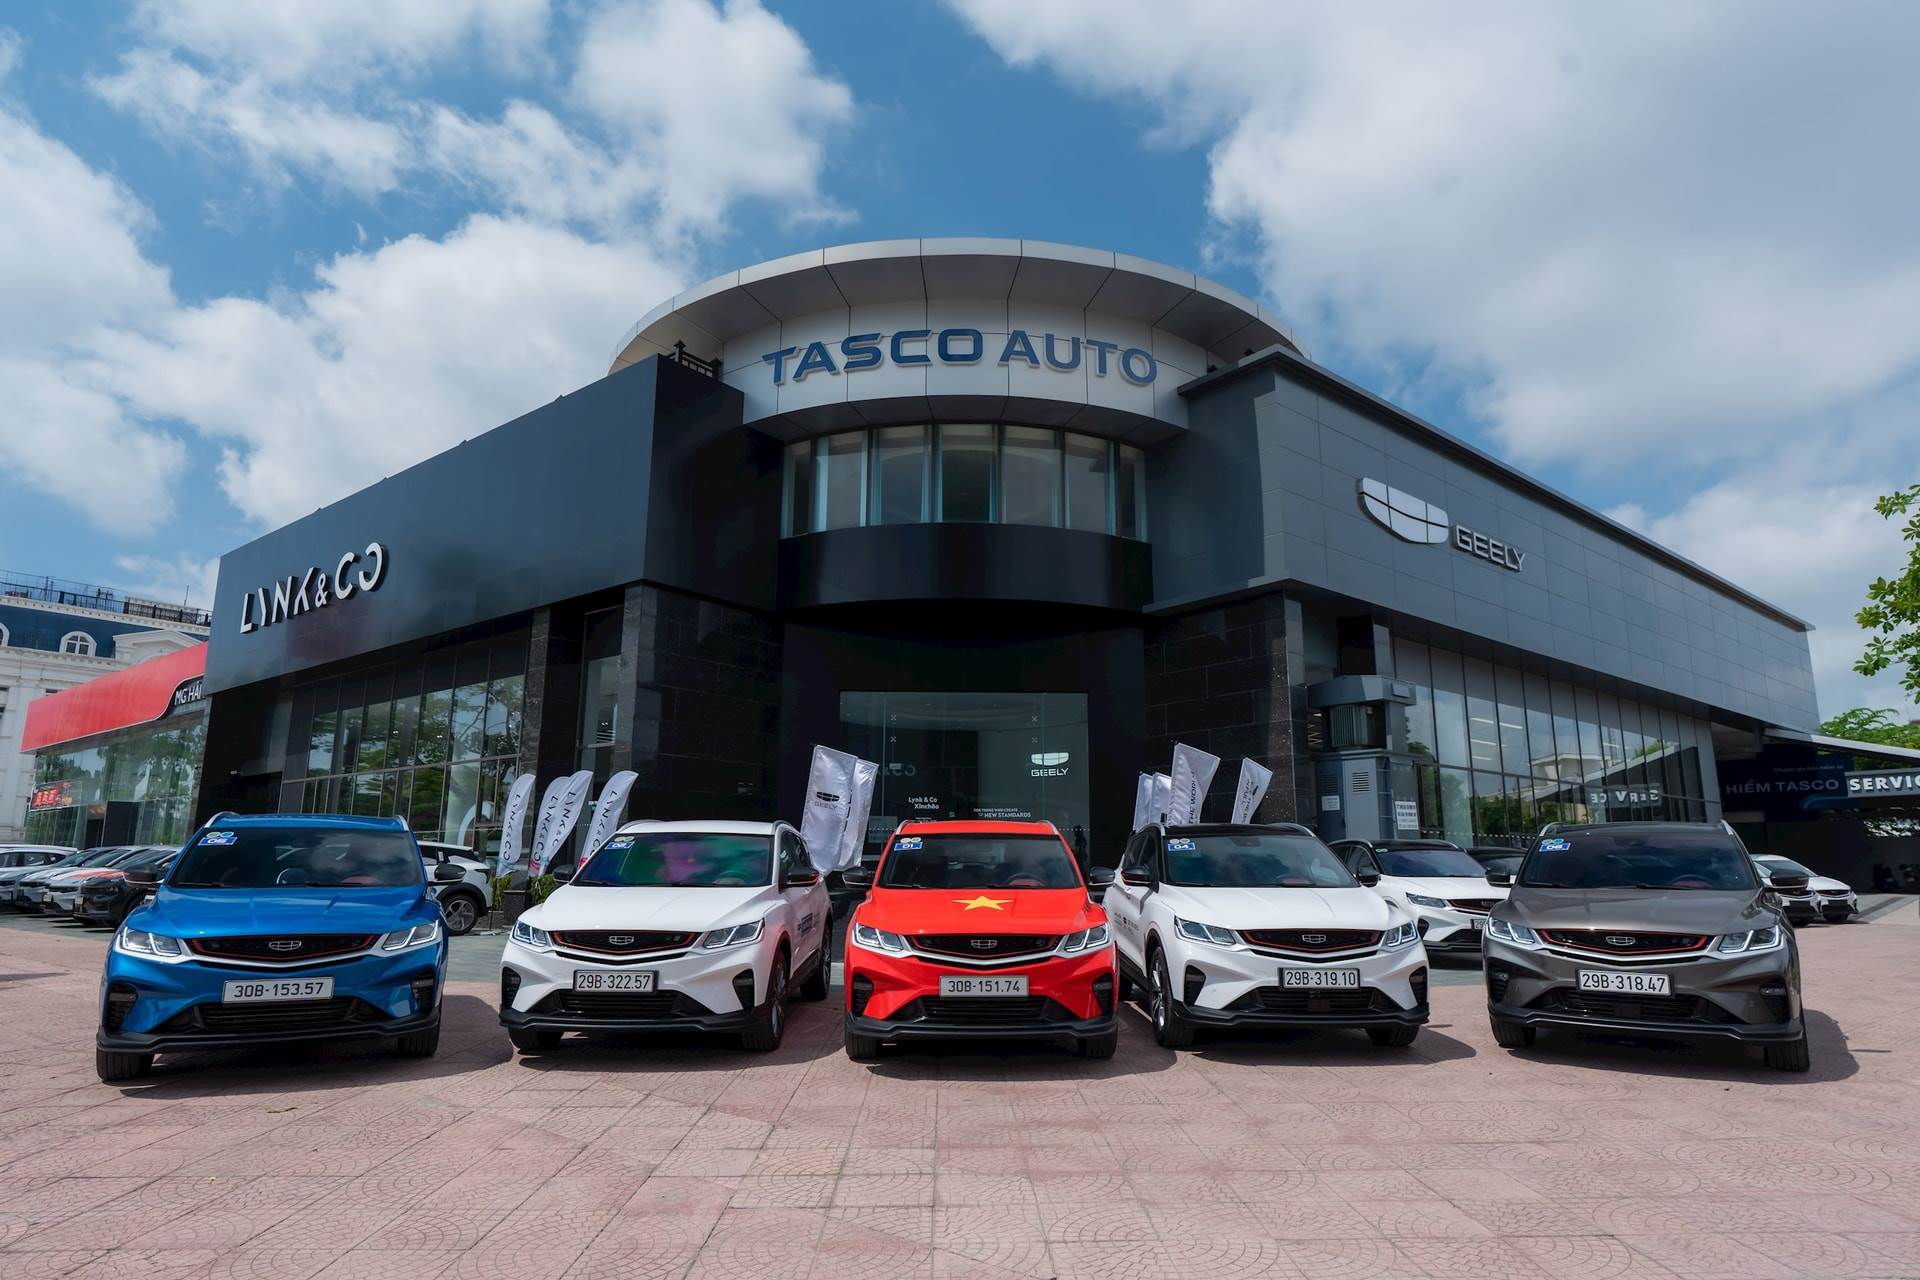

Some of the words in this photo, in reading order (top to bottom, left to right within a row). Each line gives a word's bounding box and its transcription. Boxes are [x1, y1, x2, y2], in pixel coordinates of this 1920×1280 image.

[762, 328, 984, 386] TASCO
[998, 329, 1159, 386] AUTO
[1454, 524, 1526, 572] GEELY
[174, 688, 188, 705] MG
[1031, 767, 1069, 777] GEELY
[1776, 779, 1839, 793] TASCO
[578, 974, 651, 990] 29B-322.57
[948, 980, 1020, 993] 30B-151.74
[1286, 971, 1356, 986] 29B-319.10
[1582, 973, 1666, 992] 29B-318.47
[233, 982, 324, 998] 30B-153.57
